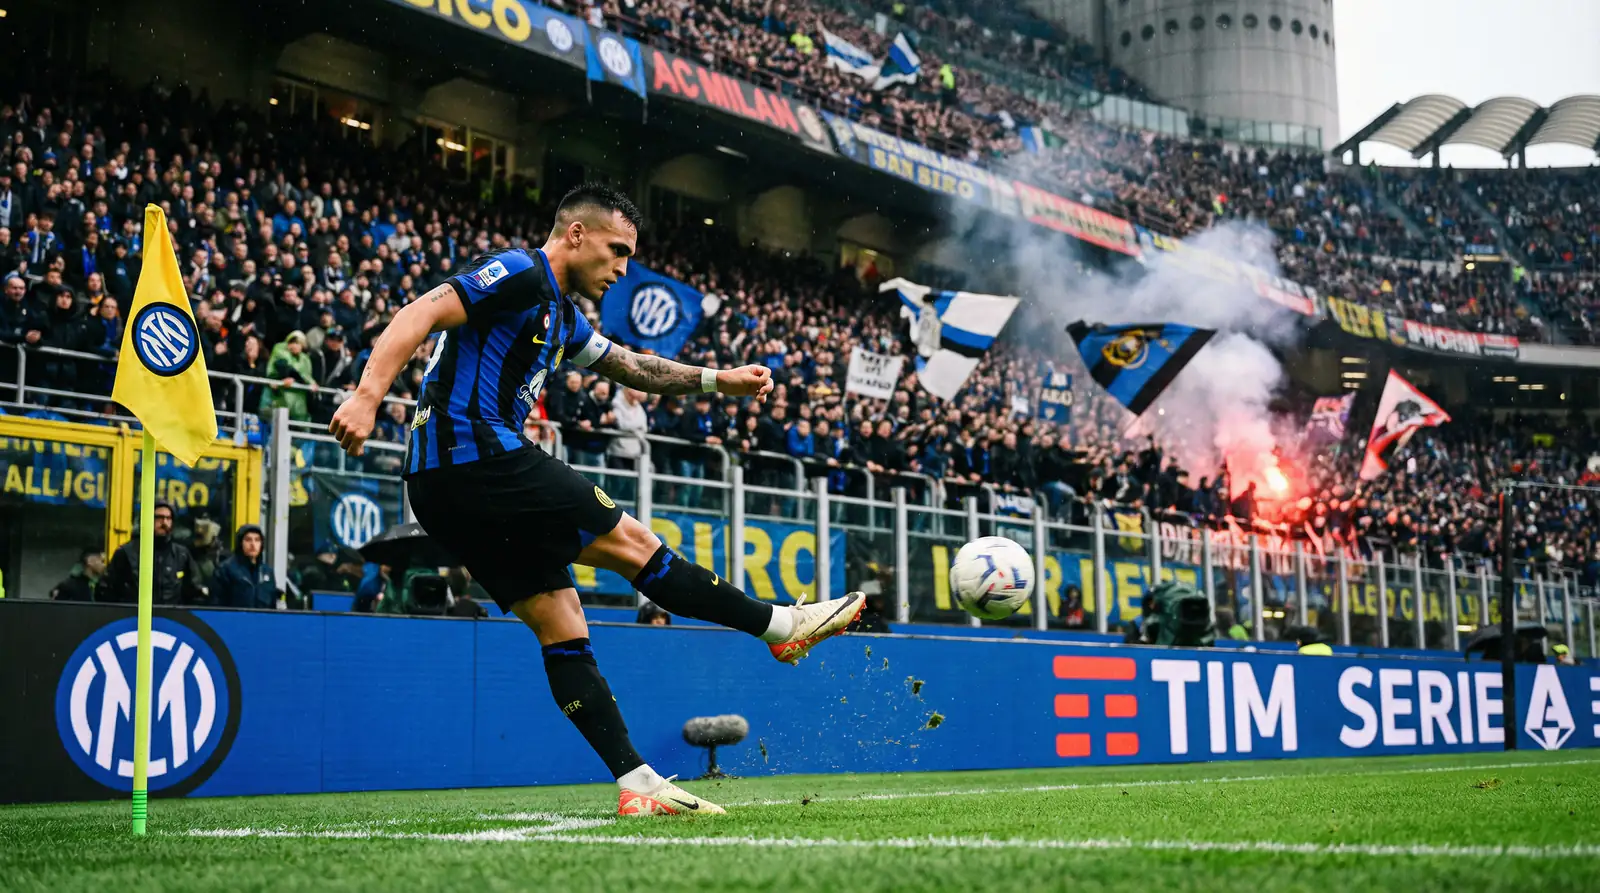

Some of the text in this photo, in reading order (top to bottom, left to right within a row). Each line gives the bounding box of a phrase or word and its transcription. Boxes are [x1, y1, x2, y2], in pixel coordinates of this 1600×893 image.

[653, 50, 800, 134] AC MILAN
[138, 478, 209, 509] IRO
[1151, 658, 1298, 755] TIM
[1338, 665, 1505, 750] SERIE
